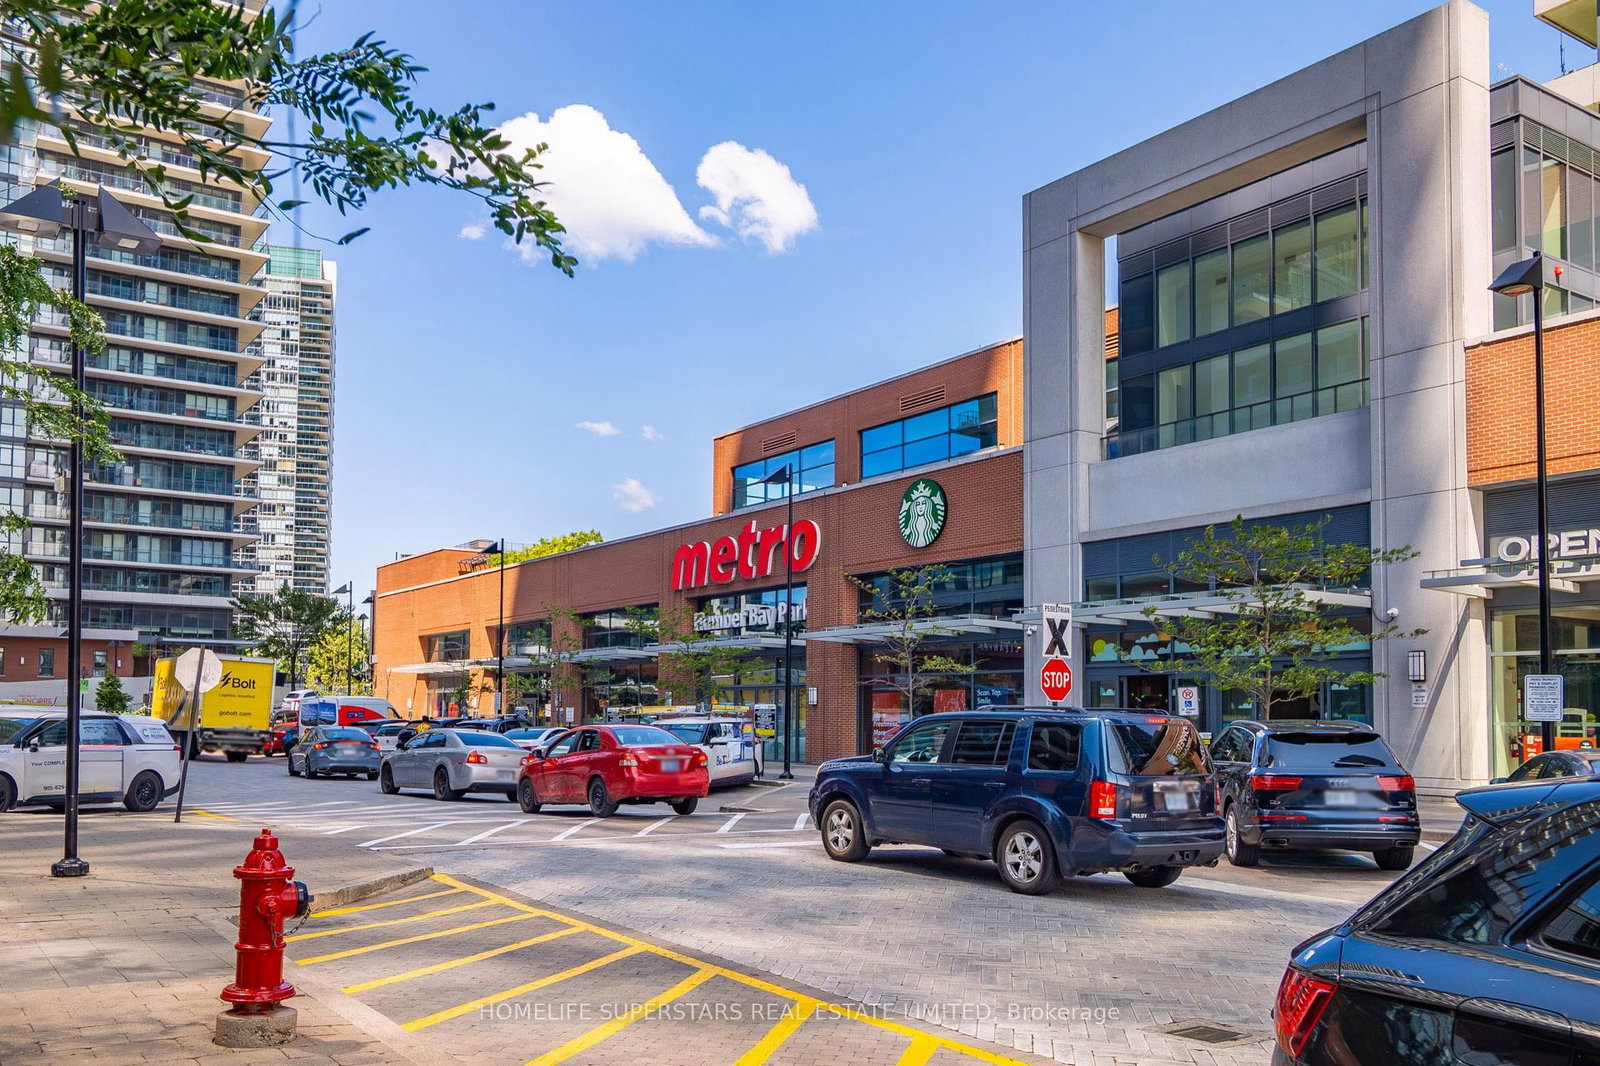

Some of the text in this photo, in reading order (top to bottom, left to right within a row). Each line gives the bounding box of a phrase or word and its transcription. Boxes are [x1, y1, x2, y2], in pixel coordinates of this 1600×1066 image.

[670, 519, 821, 591] metro
[748, 605, 777, 630] Bay
[1044, 605, 1070, 614] PEDESTRIAN
[1045, 617, 1069, 656] X
[232, 677, 256, 689] Bolt
[1043, 671, 1070, 689] STOP
